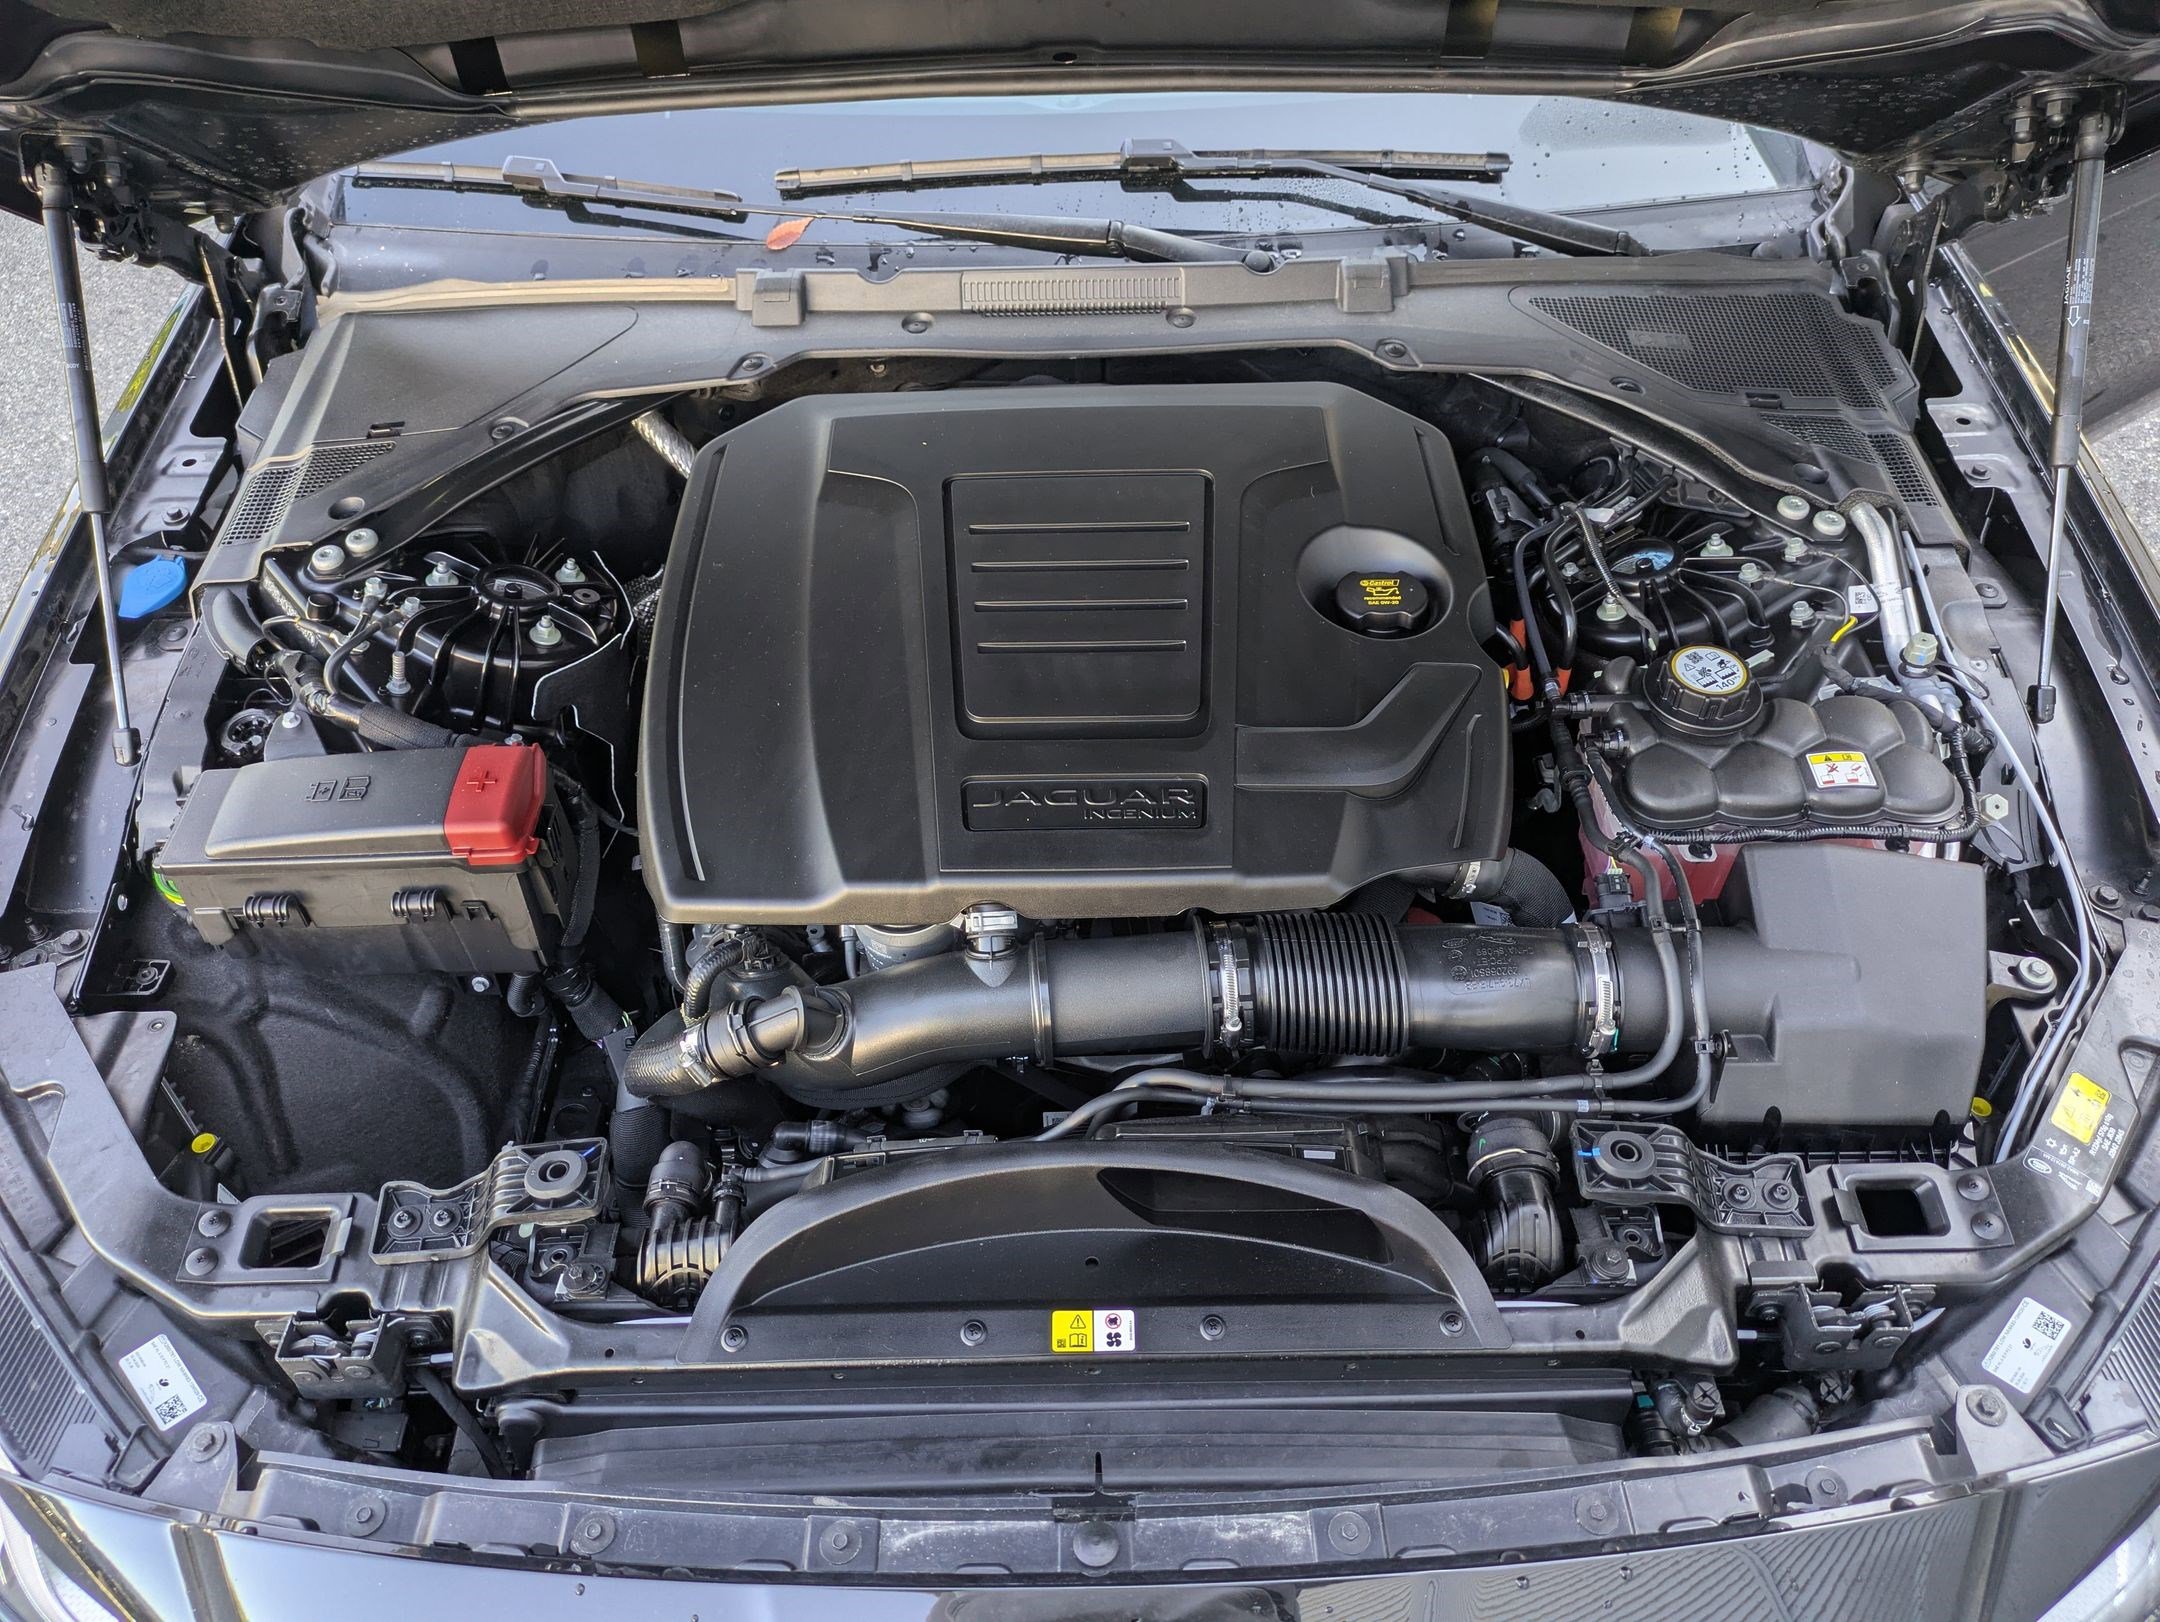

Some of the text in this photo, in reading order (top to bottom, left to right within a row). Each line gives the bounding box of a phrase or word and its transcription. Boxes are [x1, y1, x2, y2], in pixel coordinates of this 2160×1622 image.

[1715, 680, 1735, 690] 140
[972, 789, 1196, 807] JAGUAR
[1083, 808, 1197, 820] INGENIUM
